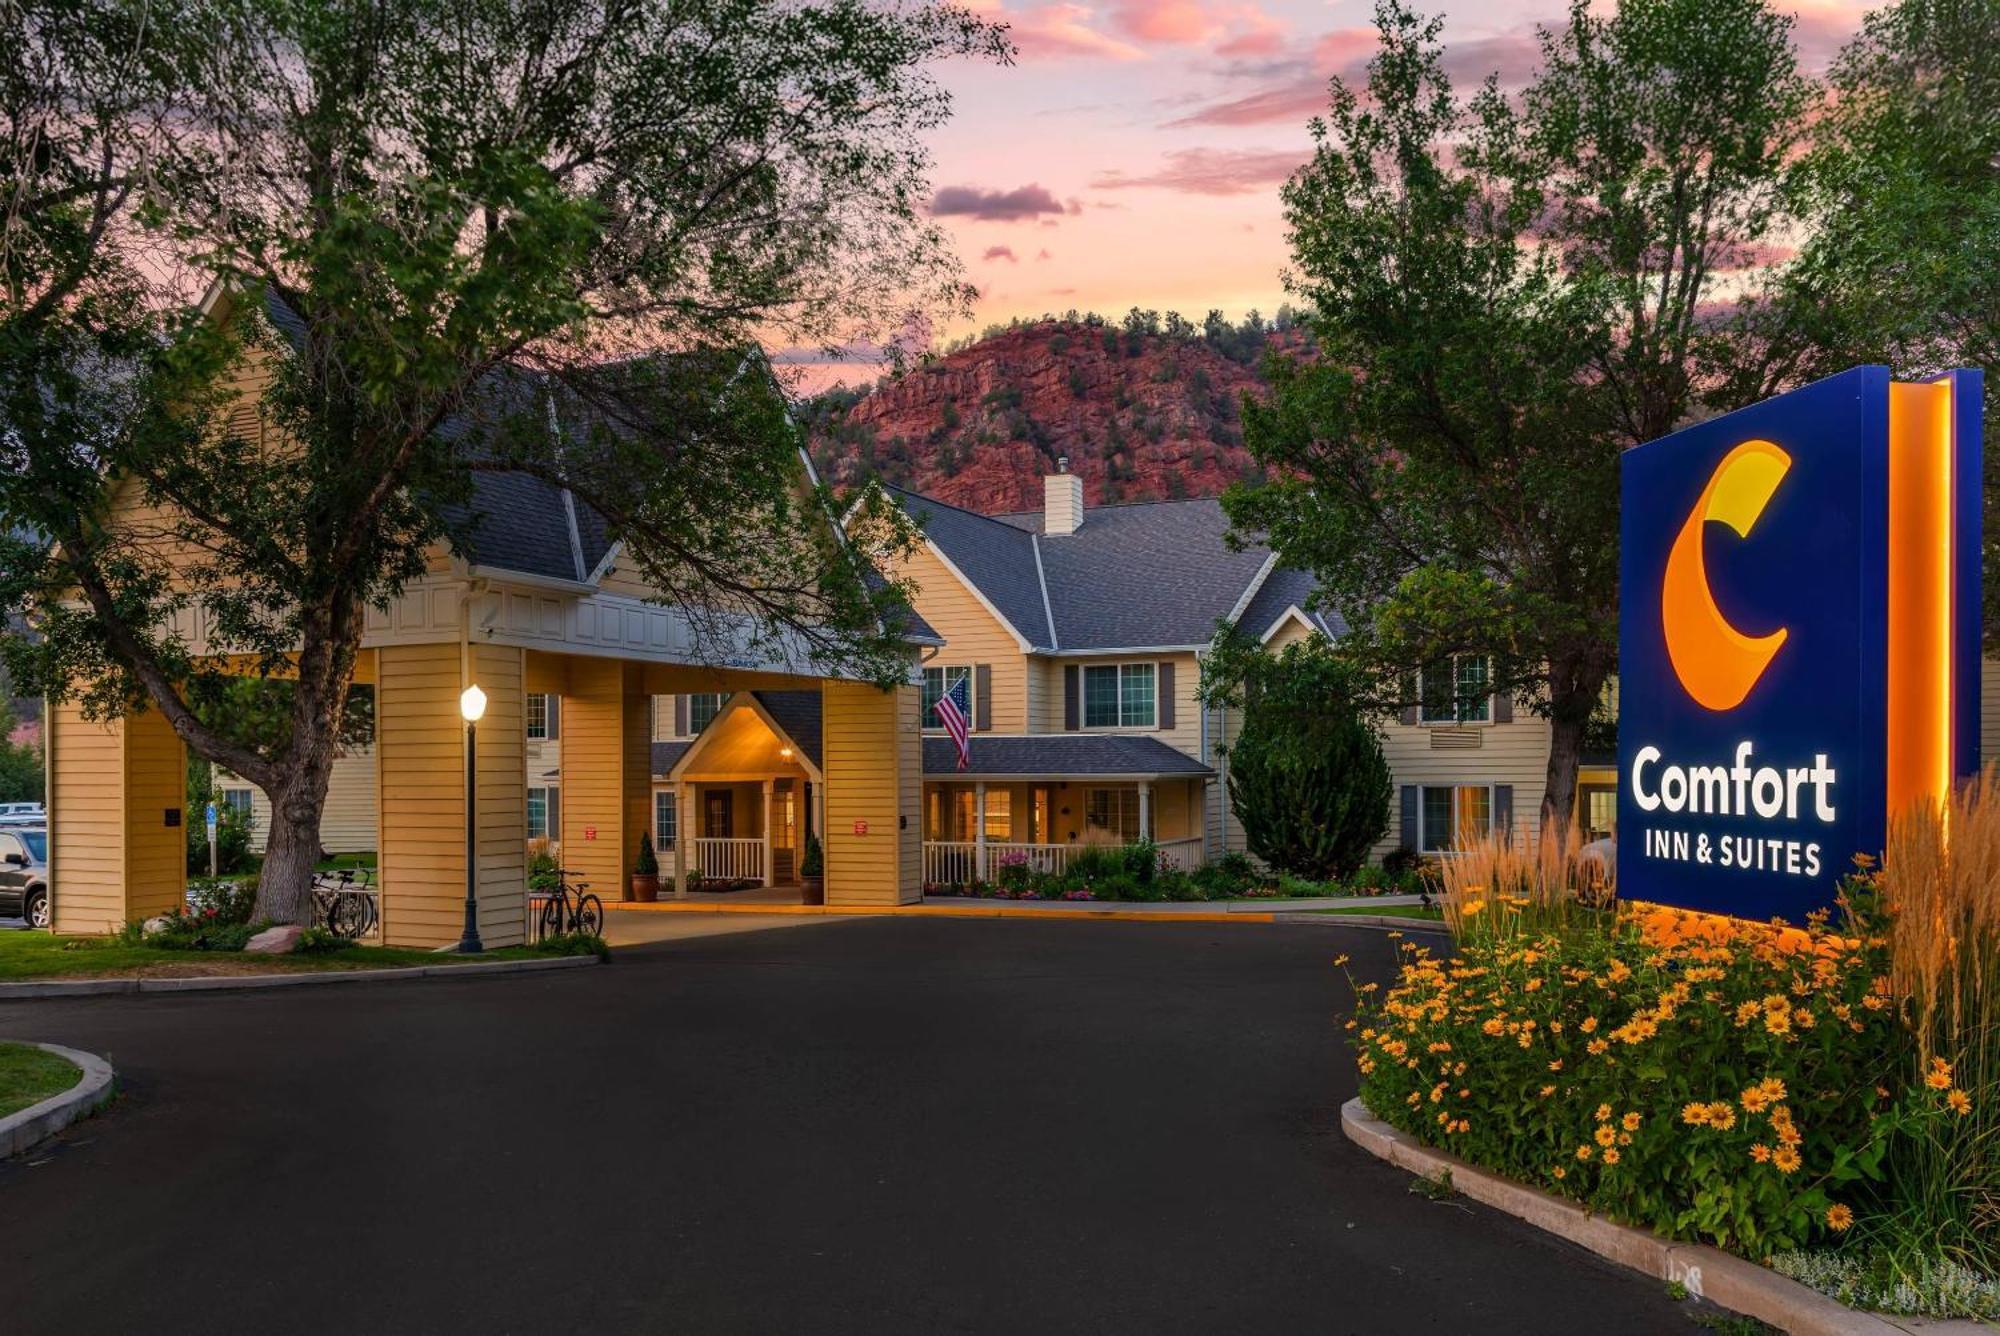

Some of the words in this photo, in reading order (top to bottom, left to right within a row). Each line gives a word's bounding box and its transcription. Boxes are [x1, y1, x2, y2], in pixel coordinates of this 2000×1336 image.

[1632, 741, 1836, 822] Comfort
[1646, 829, 1689, 861] INN
[1696, 833, 1713, 864] &
[1719, 835, 1821, 877] SUITES
